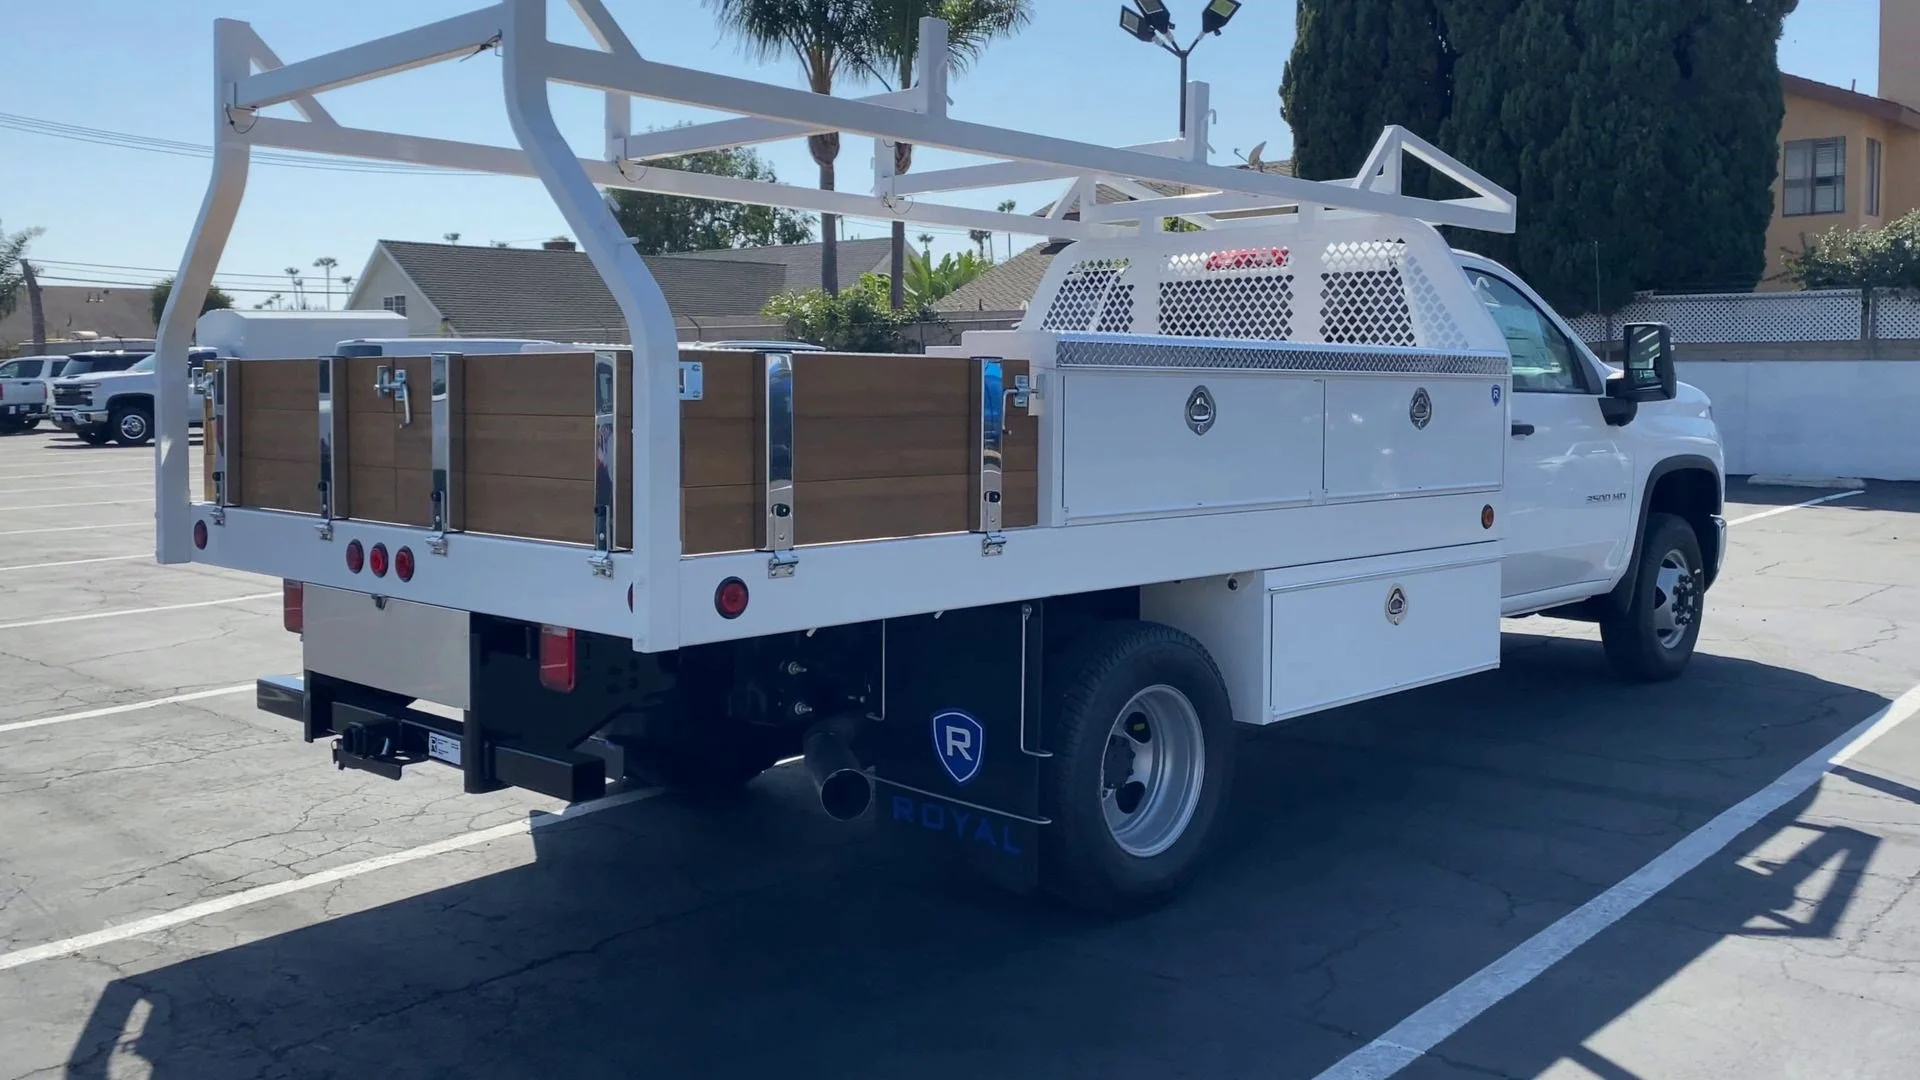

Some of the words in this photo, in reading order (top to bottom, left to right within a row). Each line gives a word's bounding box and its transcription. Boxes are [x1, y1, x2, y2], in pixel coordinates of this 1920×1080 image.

[1612, 492, 1627, 501] HD
[946, 725, 973, 761] R
[891, 795, 1022, 853] ROYAL
